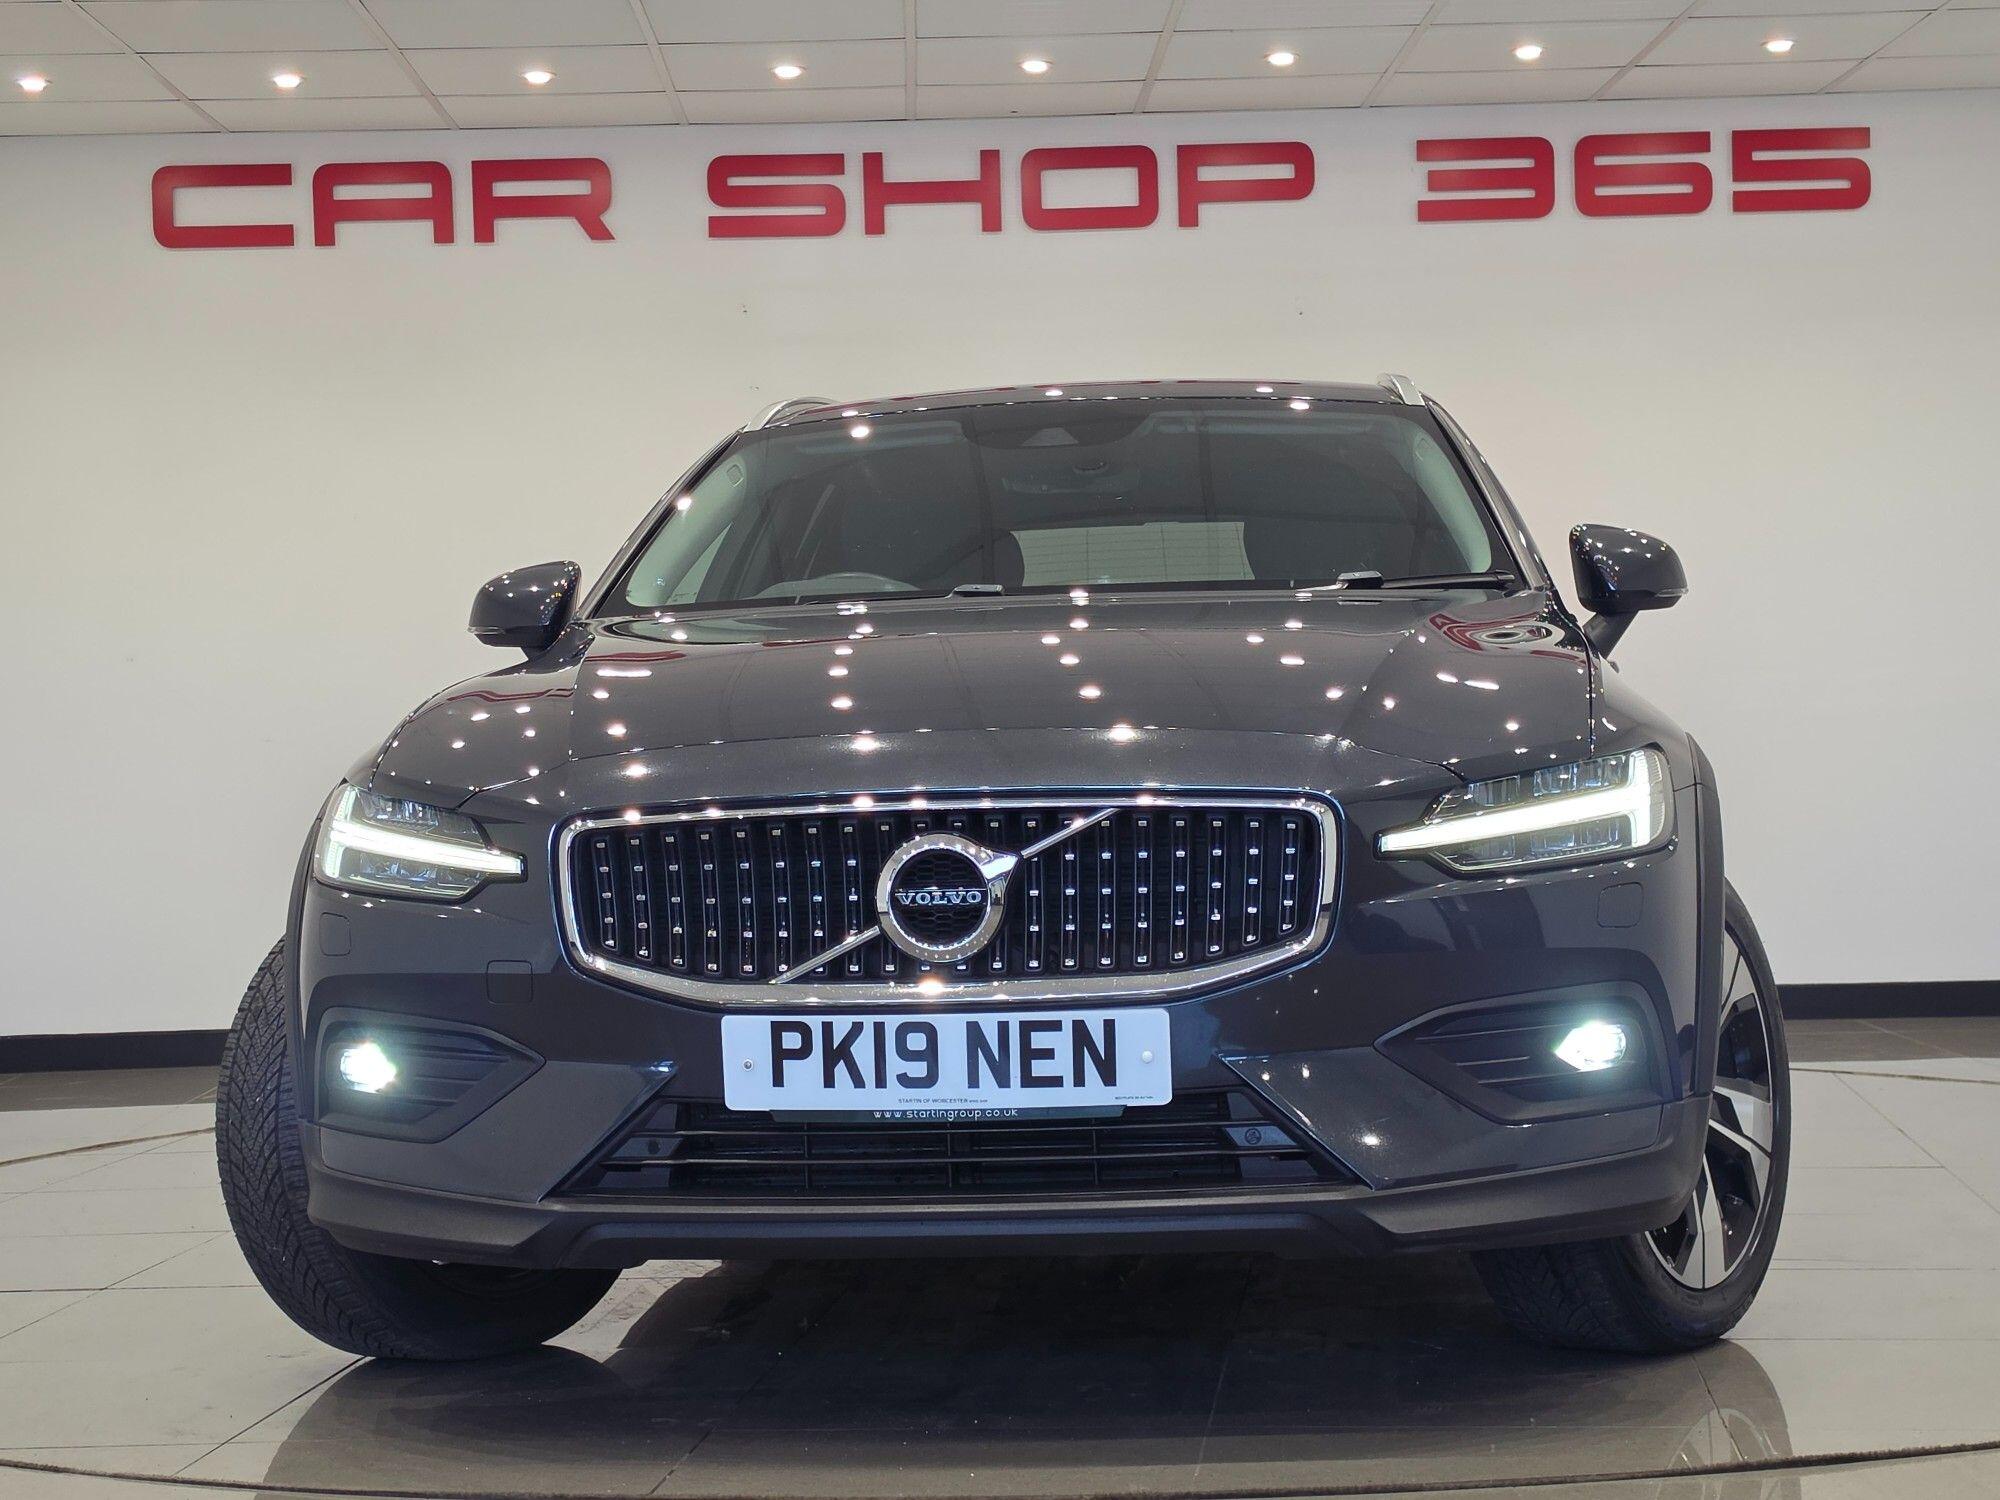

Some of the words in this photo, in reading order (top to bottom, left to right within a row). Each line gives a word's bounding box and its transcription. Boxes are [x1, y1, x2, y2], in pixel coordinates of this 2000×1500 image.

[152, 158, 614, 249] CAR
[707, 142, 1316, 239] SHOP
[1417, 128, 1872, 223] 365
[895, 890, 982, 906] VOLVO
[770, 1020, 939, 1089] PK19
[966, 1018, 1118, 1089] NEN
[873, 1108, 1019, 1122] www.startingroup.co.uk
